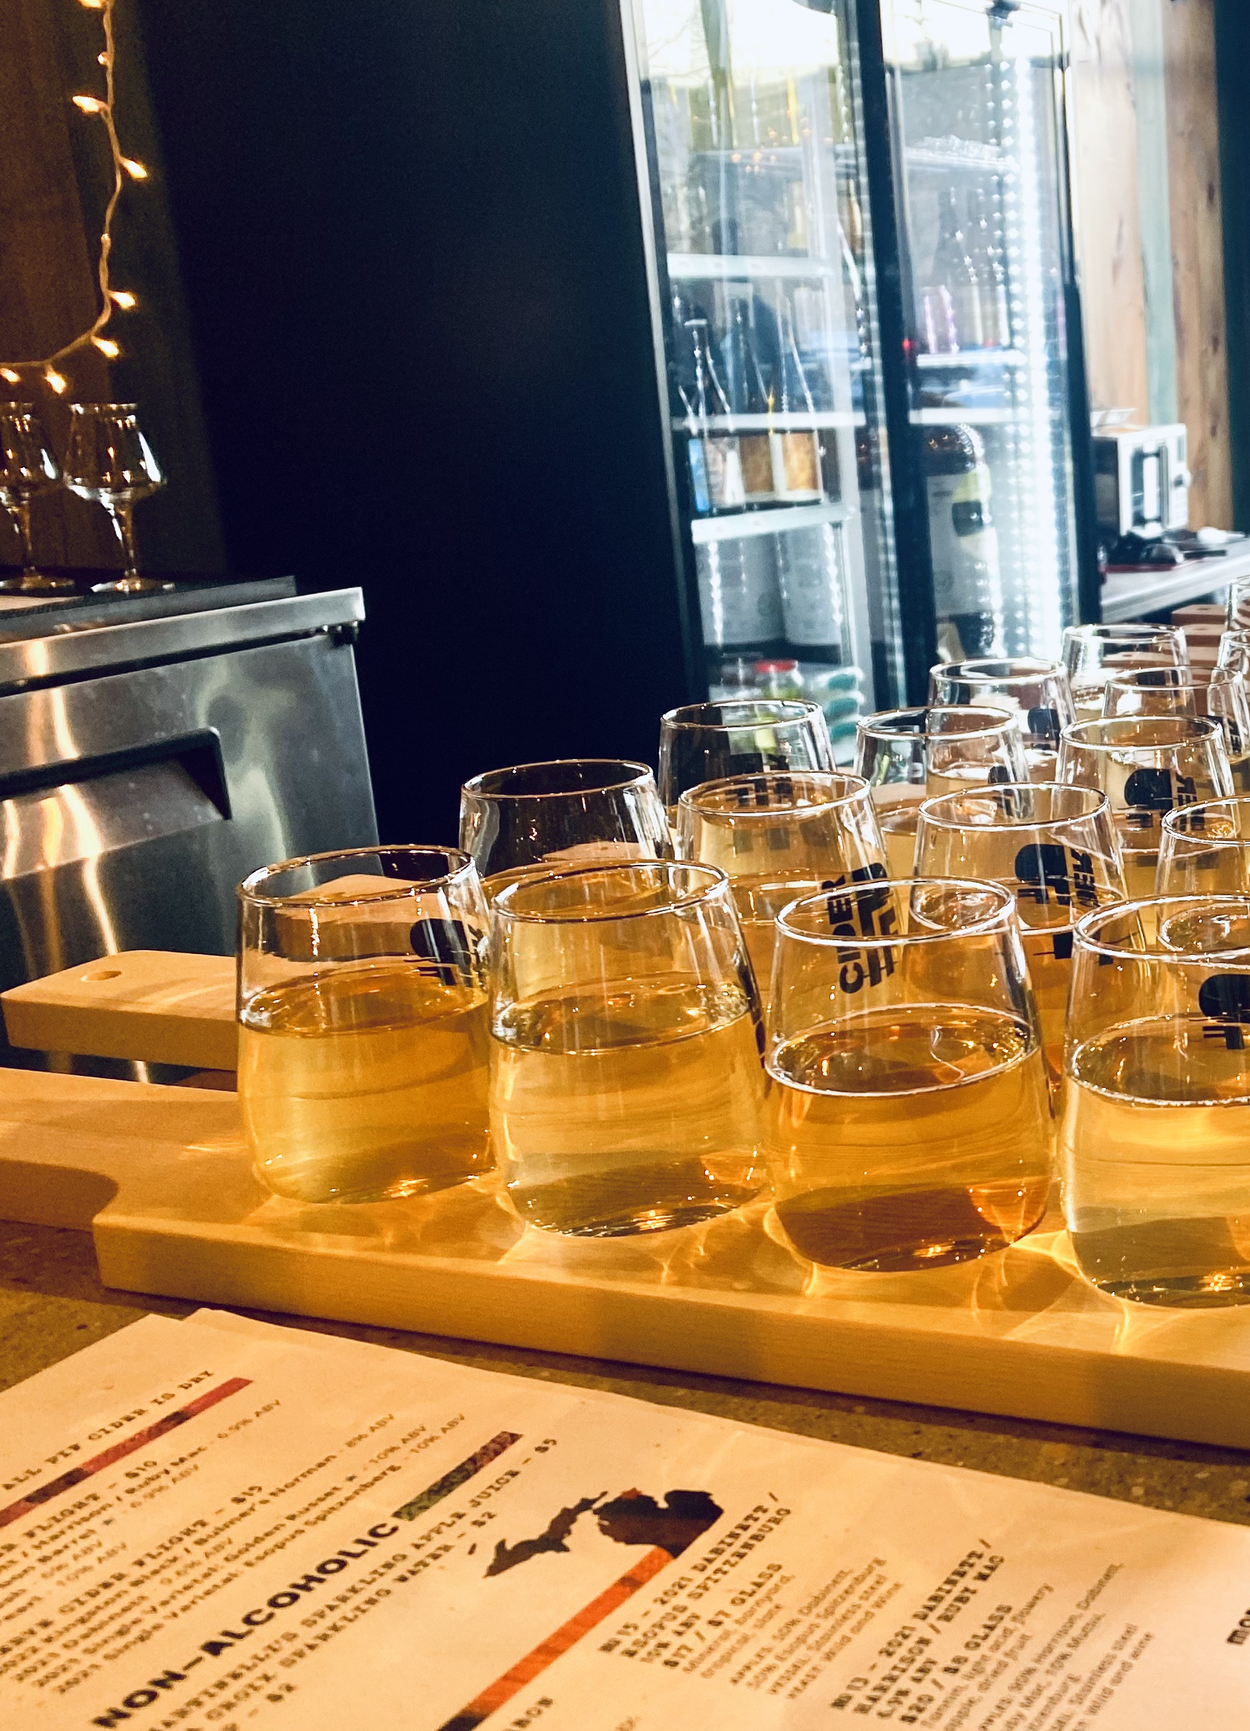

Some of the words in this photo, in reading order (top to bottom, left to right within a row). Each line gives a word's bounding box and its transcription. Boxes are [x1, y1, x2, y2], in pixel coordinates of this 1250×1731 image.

[821, 874, 864, 994] CIDER
[1, 1468, 42, 1491] ALL
[87, 1408, 147, 1441] CIDER
[149, 1392, 176, 1406] IS
[177, 1369, 214, 1390] DRY
[31, 1502, 113, 1550] Harrison
[124, 1468, 171, 1495] Ruby
[169, 1446, 207, 1467] Mac
[253, 1398, 281, 1418] ABV
[22, 1492, 101, 1539] FLIGHT
[124, 1460, 158, 1479] $10
[36, 1528, 96, 1564] Barrel
[170, 1463, 199, 1485] ABV
[40, 1589, 129, 1644] Kingston
[128, 1555, 179, 1588] Black
[192, 1498, 270, 1547] Bulmer's
[268, 1454, 337, 1497] Norman
[368, 1413, 395, 1433] ABV
[59, 1572, 127, 1614] CIDER
[131, 1519, 209, 1568] FLIGHT
[230, 1485, 263, 1505] $15
[71, 1539, 103, 1562] ABV
[81, 1617, 143, 1655] Single
[222, 1522, 286, 1563] Golden
[284, 1485, 342, 1521] Russet
[400, 1425, 427, 1445] ABV
[96, 1541, 127, 1565] ABV
[102, 1622, 164, 1661] Single
[242, 1528, 306, 1568] Esopus
[439, 1413, 465, 1434] ABV
[300, 1553, 408, 1628] SPARKLING
[410, 1511, 467, 1550] APPLE
[469, 1469, 521, 1508] JUICE
[533, 1438, 557, 1454] $5
[652, 1576, 693, 1606] 2021
[690, 1504, 769, 1572] DABINETT
[61, 1595, 148, 1650] Dabinett
[203, 1536, 234, 1560] ABV
[93, 1523, 398, 1728] NON-ALCOHOLIC
[205, 1672, 276, 1720] CROIX
[279, 1588, 392, 1668] SPARKLING
[393, 1544, 453, 1583] WATER
[470, 1511, 497, 1528] $2
[620, 1604, 688, 1658] ESOPUS
[687, 1507, 791, 1599] SPITZENBURG
[662, 1643, 693, 1668] $17
[706, 1609, 731, 1627] $7
[730, 1563, 783, 1606] GLASS
[672, 1612, 701, 1637] ABV
[849, 1609, 876, 1635] and
[853, 1636, 932, 1714] HARRISON
[936, 1586, 978, 1623] RUBY
[972, 1555, 1004, 1582] MAC
[858, 1573, 887, 1601] steel
[877, 1625, 916, 1658] 2021
[912, 1550, 984, 1621] DABINETT
[1010, 1582, 1054, 1625] flowery
[265, 1683, 295, 1703] $2
[898, 1694, 934, 1725] $20
[963, 1604, 1013, 1651] GLASS
[977, 1659, 1009, 1693] dried
[1002, 1632, 1033, 1662] fruit
